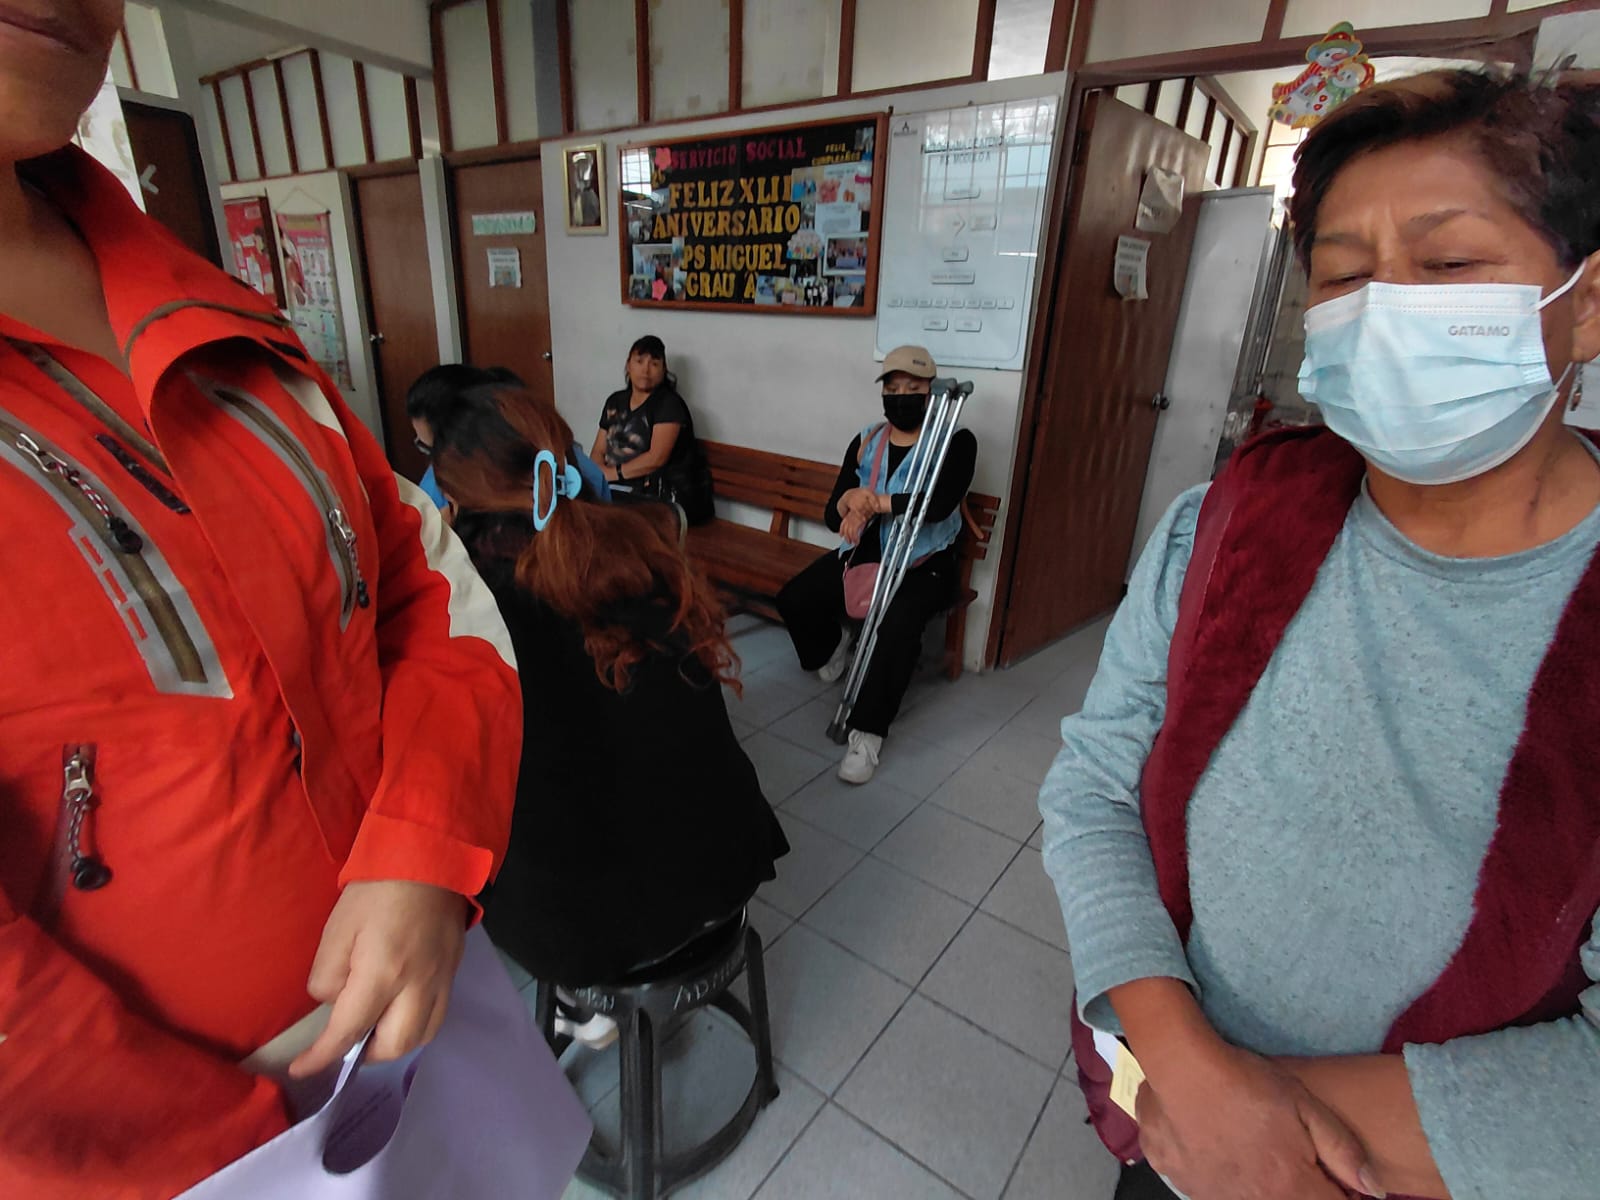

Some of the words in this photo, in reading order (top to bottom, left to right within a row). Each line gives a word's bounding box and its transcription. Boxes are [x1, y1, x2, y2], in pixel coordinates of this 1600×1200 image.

[671, 143, 737, 170] SERVICIO
[746, 136, 806, 162] SOCIAL
[669, 178, 735, 208] FELIZ
[652, 203, 800, 239] ANIVERSARIO
[680, 244, 705, 270] PS
[710, 242, 786, 271] MIGUEL
[686, 272, 736, 298] GRAU
[1447, 324, 1510, 336] GATAMO
